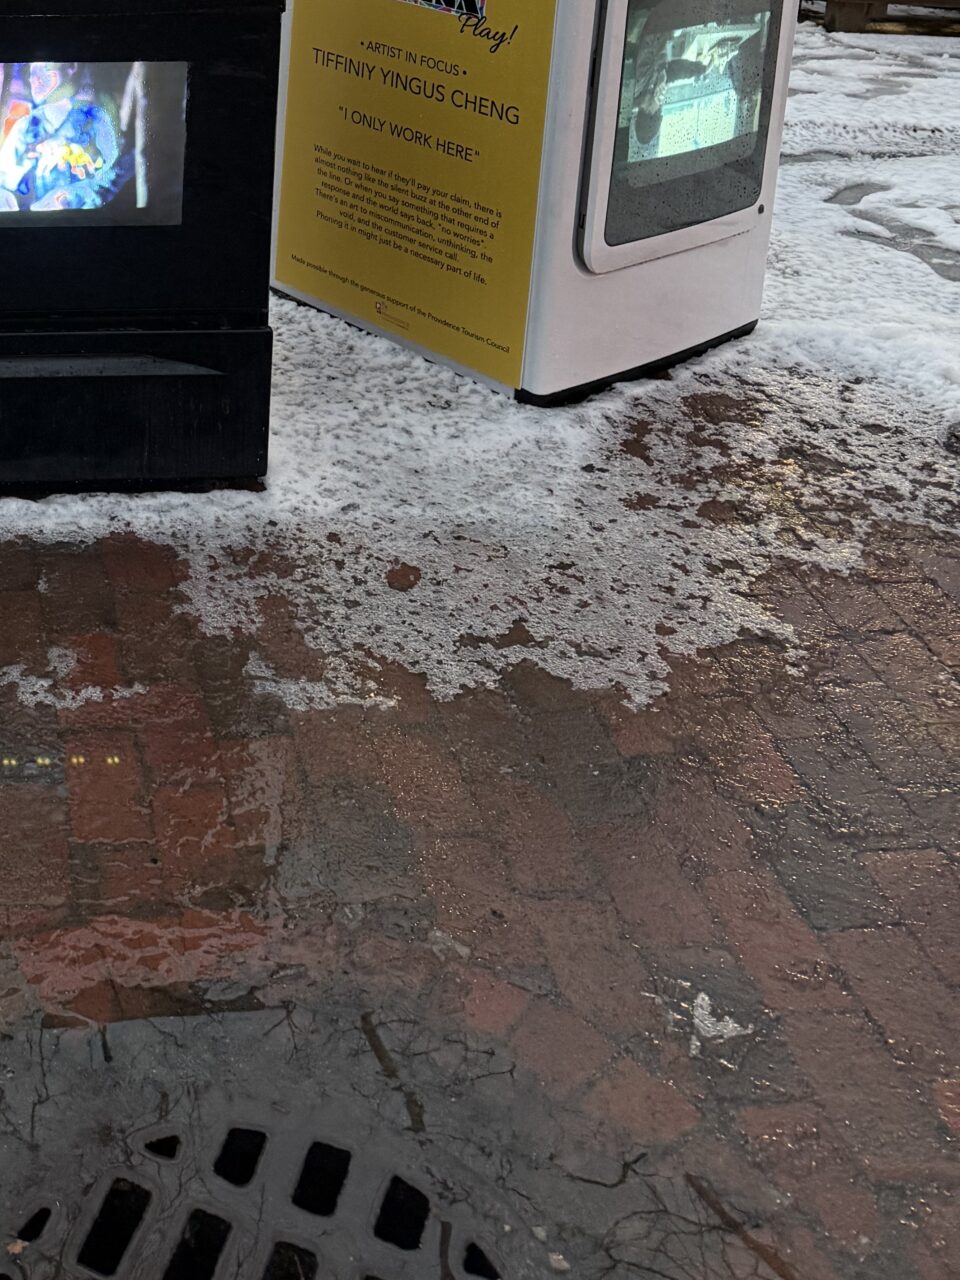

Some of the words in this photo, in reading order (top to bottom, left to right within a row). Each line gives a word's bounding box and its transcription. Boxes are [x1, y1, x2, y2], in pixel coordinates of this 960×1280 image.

[366, 41, 402, 59] ARTIST
[405, 51, 417, 64] IN
[420, 55, 460, 76] FOCUS
[458, 13, 519, 53] Play!
[312, 47, 376, 80] TIFFINIY
[381, 67, 445, 102] YINGUS
[451, 90, 520, 125] CHENG
[339, 105, 348, 120] "I
[351, 110, 386, 132] ONLY
[389, 122, 432, 149] WORK
[436, 138, 480, 162] HERE"
[314, 144, 332, 157] While
[333, 152, 345, 161] you
[347, 157, 361, 167] wait
[362, 162, 370, 170] to
[371, 164, 386, 176] hear
[394, 172, 416, 186] they'll
[417, 183, 430, 193] pay
[432, 188, 448, 198] your
[450, 194, 472, 208] claim,
[474, 201, 494, 215] there
[495, 209, 502, 218] is
[314, 157, 336, 169] almost
[337, 165, 363, 180] nothing
[364, 173, 376, 183] like
[378, 179, 388, 188] the
[391, 184, 409, 196] silent
[411, 192, 427, 203] buzz
[438, 201, 451, 211] the
[452, 207, 472, 218] other
[474, 215, 489, 226] end
[491, 221, 500, 229] of
[317, 167, 328, 177] the
[344, 177, 353, 186] Or
[354, 182, 373, 194] when
[374, 191, 387, 200] you
[388, 195, 400, 205] say
[401, 200, 439, 220] something
[441, 213, 455, 225] that
[457, 221, 488, 237] requires
[321, 181, 351, 197] response
[352, 192, 365, 202] and
[366, 197, 378, 206] the
[379, 203, 399, 215] world
[400, 210, 415, 222] says
[416, 215, 436, 230] back,
[315, 188, 338, 203] There's
[340, 199, 348, 207] an
[349, 203, 358, 212] art
[360, 206, 368, 214] to
[369, 210, 435, 242] miscommunication,
[437, 236, 478, 259] unthinking,
[480, 252, 493, 263] the
[316, 209, 343, 229] Phoning
[358, 228, 378, 240] might
[379, 237, 392, 246] just
[393, 241, 403, 251] be
[410, 249, 445, 270] necessary
[446, 264, 462, 275] part
[463, 270, 472, 278] of
[473, 272, 487, 285] life.
[357, 217, 370, 227] and
[371, 222, 382, 231] the
[384, 228, 416, 245] customer
[418, 241, 443, 256] service
[291, 253, 306, 265] Made
[306, 261, 328, 274] possible
[328, 270, 350, 284] through
[350, 279, 359, 287] the
[360, 284, 386, 299] generous
[386, 295, 409, 310] support
[409, 305, 416, 313] of
[416, 308, 427, 317] the
[427, 312, 461, 332] Providence
[461, 327, 486, 343] Tourism
[486, 338, 510, 353] Council
